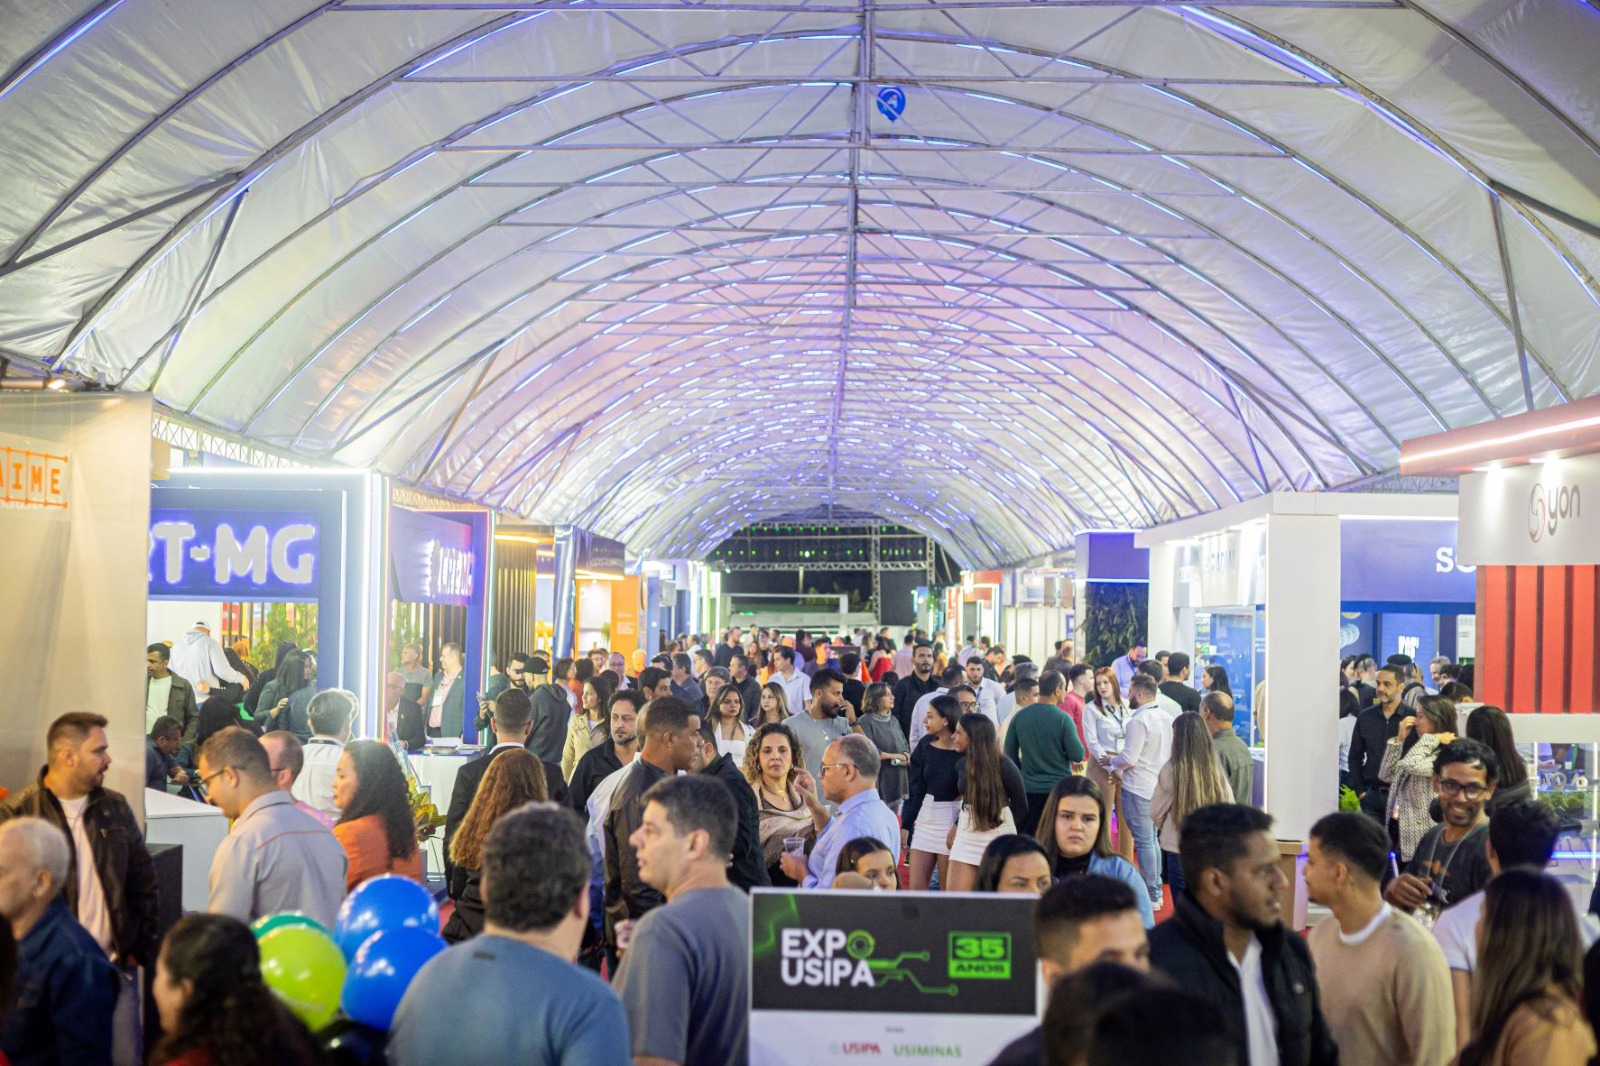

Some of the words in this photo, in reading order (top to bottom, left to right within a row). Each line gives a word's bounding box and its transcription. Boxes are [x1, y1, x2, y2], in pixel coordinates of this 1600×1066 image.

[148, 521, 316, 585] T-MG
[781, 929, 876, 959] EXPO
[954, 937, 1006, 959] 35
[781, 958, 876, 987] USIPA
[955, 964, 1005, 974] ANOS
[842, 1042, 881, 1055] USIPA
[893, 1044, 963, 1058] USIMINAS
